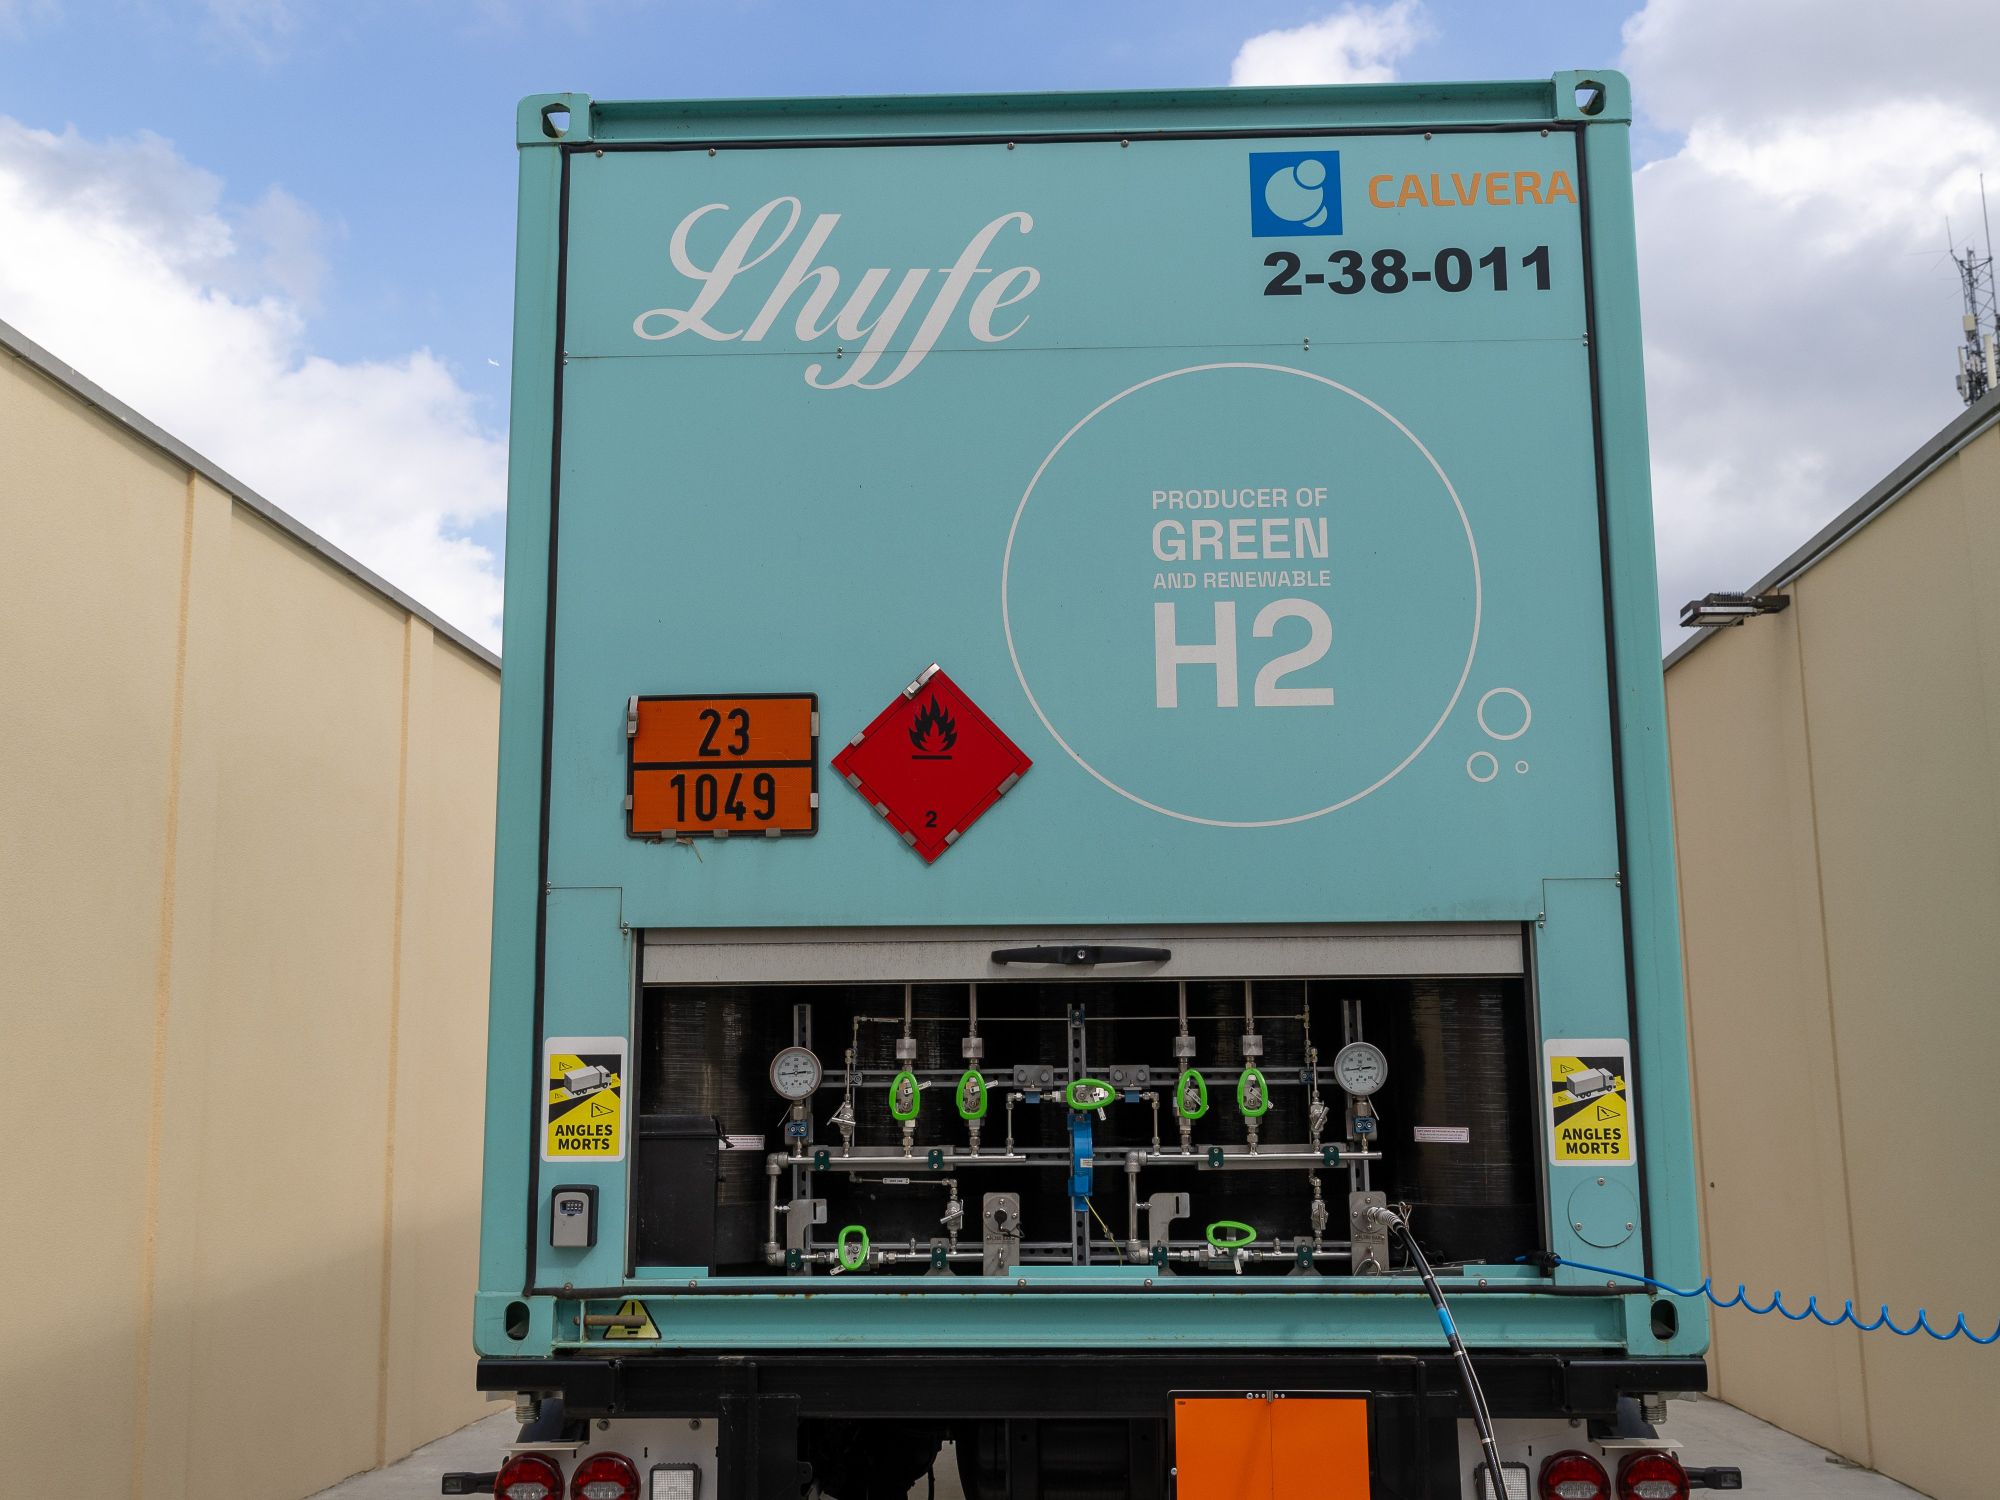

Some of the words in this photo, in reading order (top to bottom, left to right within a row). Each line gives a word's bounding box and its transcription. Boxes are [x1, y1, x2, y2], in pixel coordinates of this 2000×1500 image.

[1368, 171, 1577, 208] CALVERA
[1264, 246, 1550, 295] 2-38-011
[633, 197, 1041, 390] Lhyfe
[1152, 488, 1288, 510] PRODUCER
[1296, 487, 1328, 508] OF
[1152, 517, 1328, 561] GREEN
[1153, 572, 1197, 589] AND
[1204, 570, 1331, 588] RENEWABLE
[1154, 598, 1335, 708] H2
[699, 708, 750, 756] 23
[670, 773, 775, 823] 1049
[925, 811, 937, 828] 2
[555, 1124, 613, 1136] ANGLES
[558, 1138, 610, 1150] MORTS
[1562, 1128, 1622, 1140] ANGLES
[1566, 1142, 1620, 1155] MORTS
